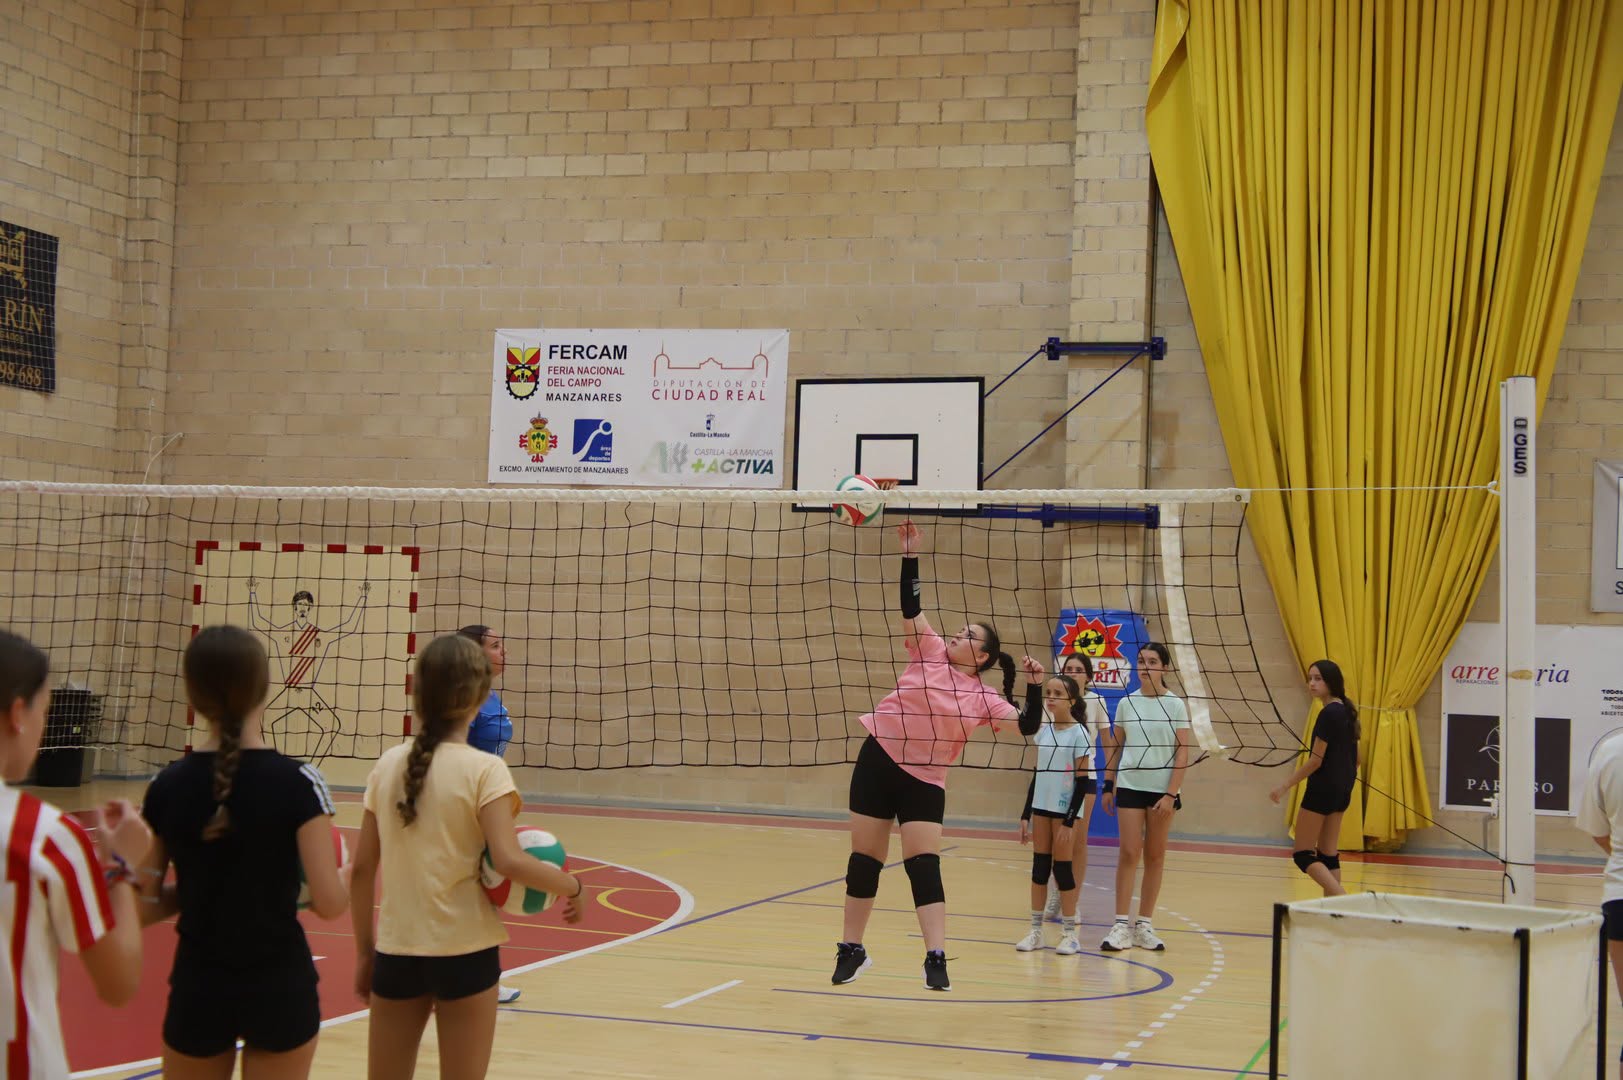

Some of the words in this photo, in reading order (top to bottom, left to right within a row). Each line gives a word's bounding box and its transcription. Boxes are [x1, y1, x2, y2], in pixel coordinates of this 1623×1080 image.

[548, 344, 628, 360] FERCAM
[18, 364, 42, 386] 688
[547, 366, 575, 375] FERIA
[577, 366, 625, 375] NACIONAL
[547, 378, 565, 387] DEL
[568, 378, 602, 387] CAMPO
[653, 378, 742, 388] DIPUTACIÓN
[751, 380, 766, 388] DE
[546, 393, 622, 402] MANZANARES
[651, 389, 719, 401] CIUDAD
[726, 389, 766, 401] REAL
[694, 448, 725, 456] CASTILLA
[499, 465, 523, 473] EXCMO.
[525, 465, 573, 473] AYUNTAMIENTO
[583, 467, 629, 475] MANZANARES
[311, 701, 323, 715] 12
